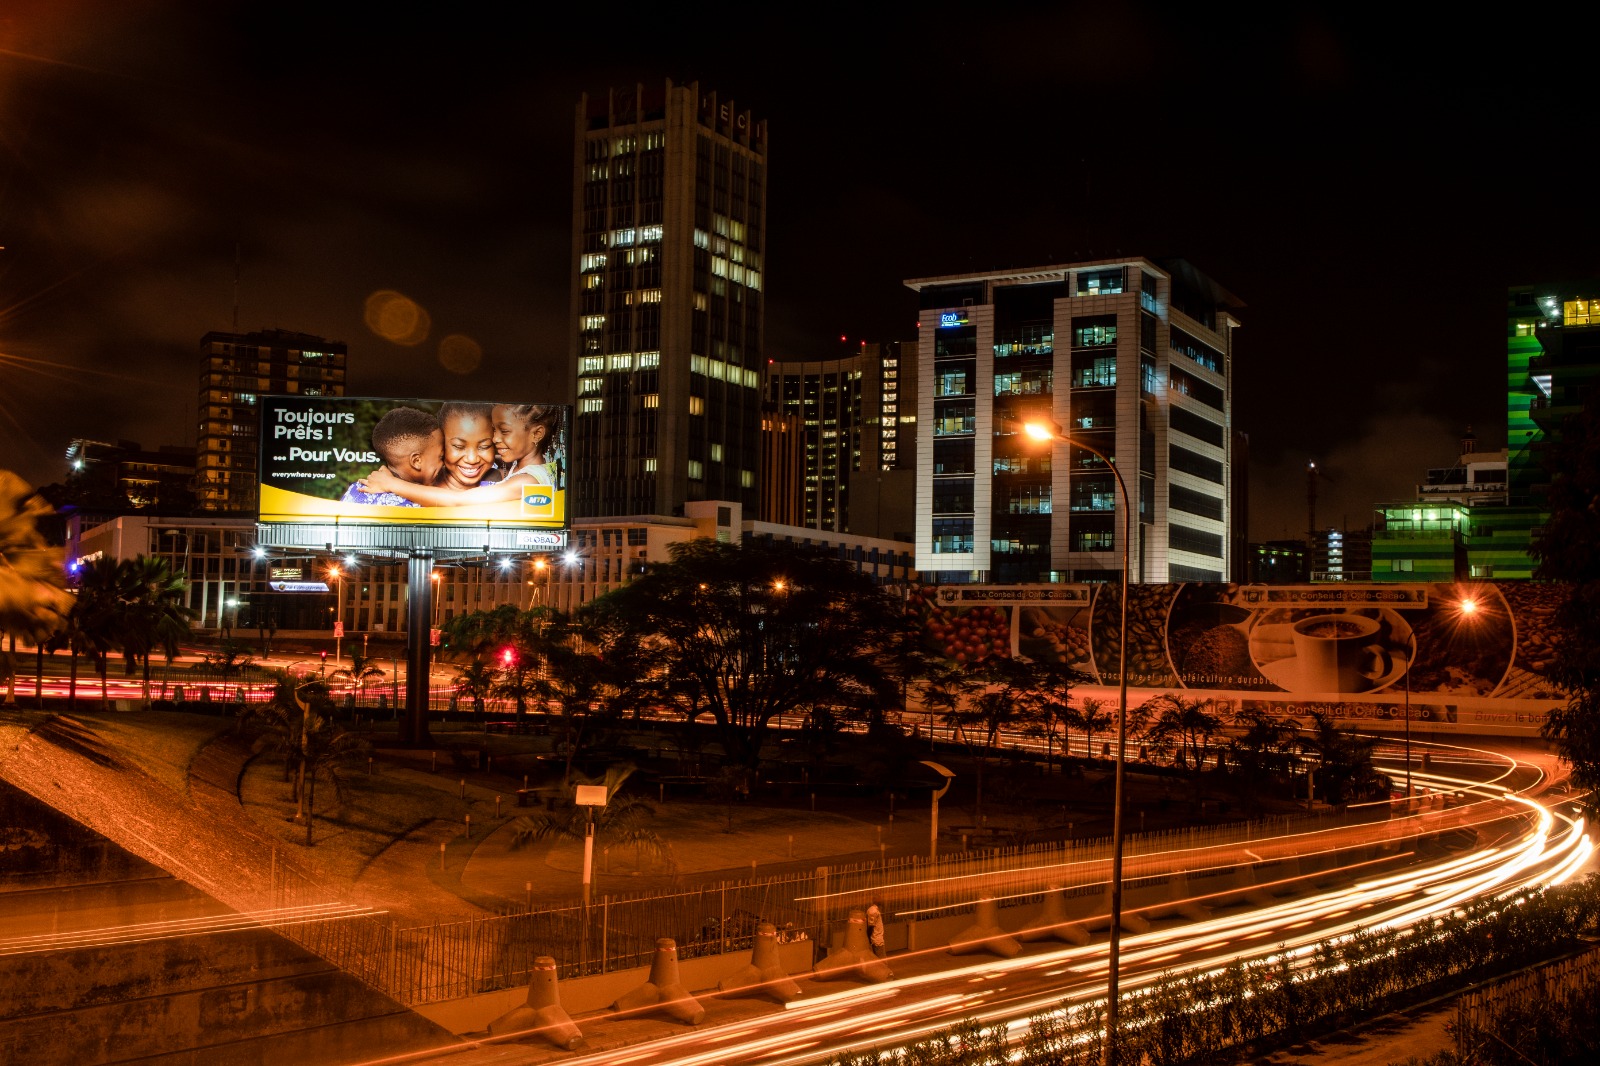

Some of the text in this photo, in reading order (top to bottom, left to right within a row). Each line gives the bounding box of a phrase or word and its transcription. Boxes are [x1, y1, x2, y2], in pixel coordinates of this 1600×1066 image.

[274, 408, 355, 426] Toujours
[274, 424, 323, 441] Prêts
[289, 447, 332, 462] Pour
[332, 447, 381, 463] Vous.
[272, 471, 311, 479] everywhere
[528, 496, 547, 504] MTN
[523, 535, 555, 544] GLOBAL
[1267, 703, 1430, 718] Le Conseil du Café-Cacao
[1474, 711, 1511, 721] Buvez
[1515, 712, 1525, 722] le
